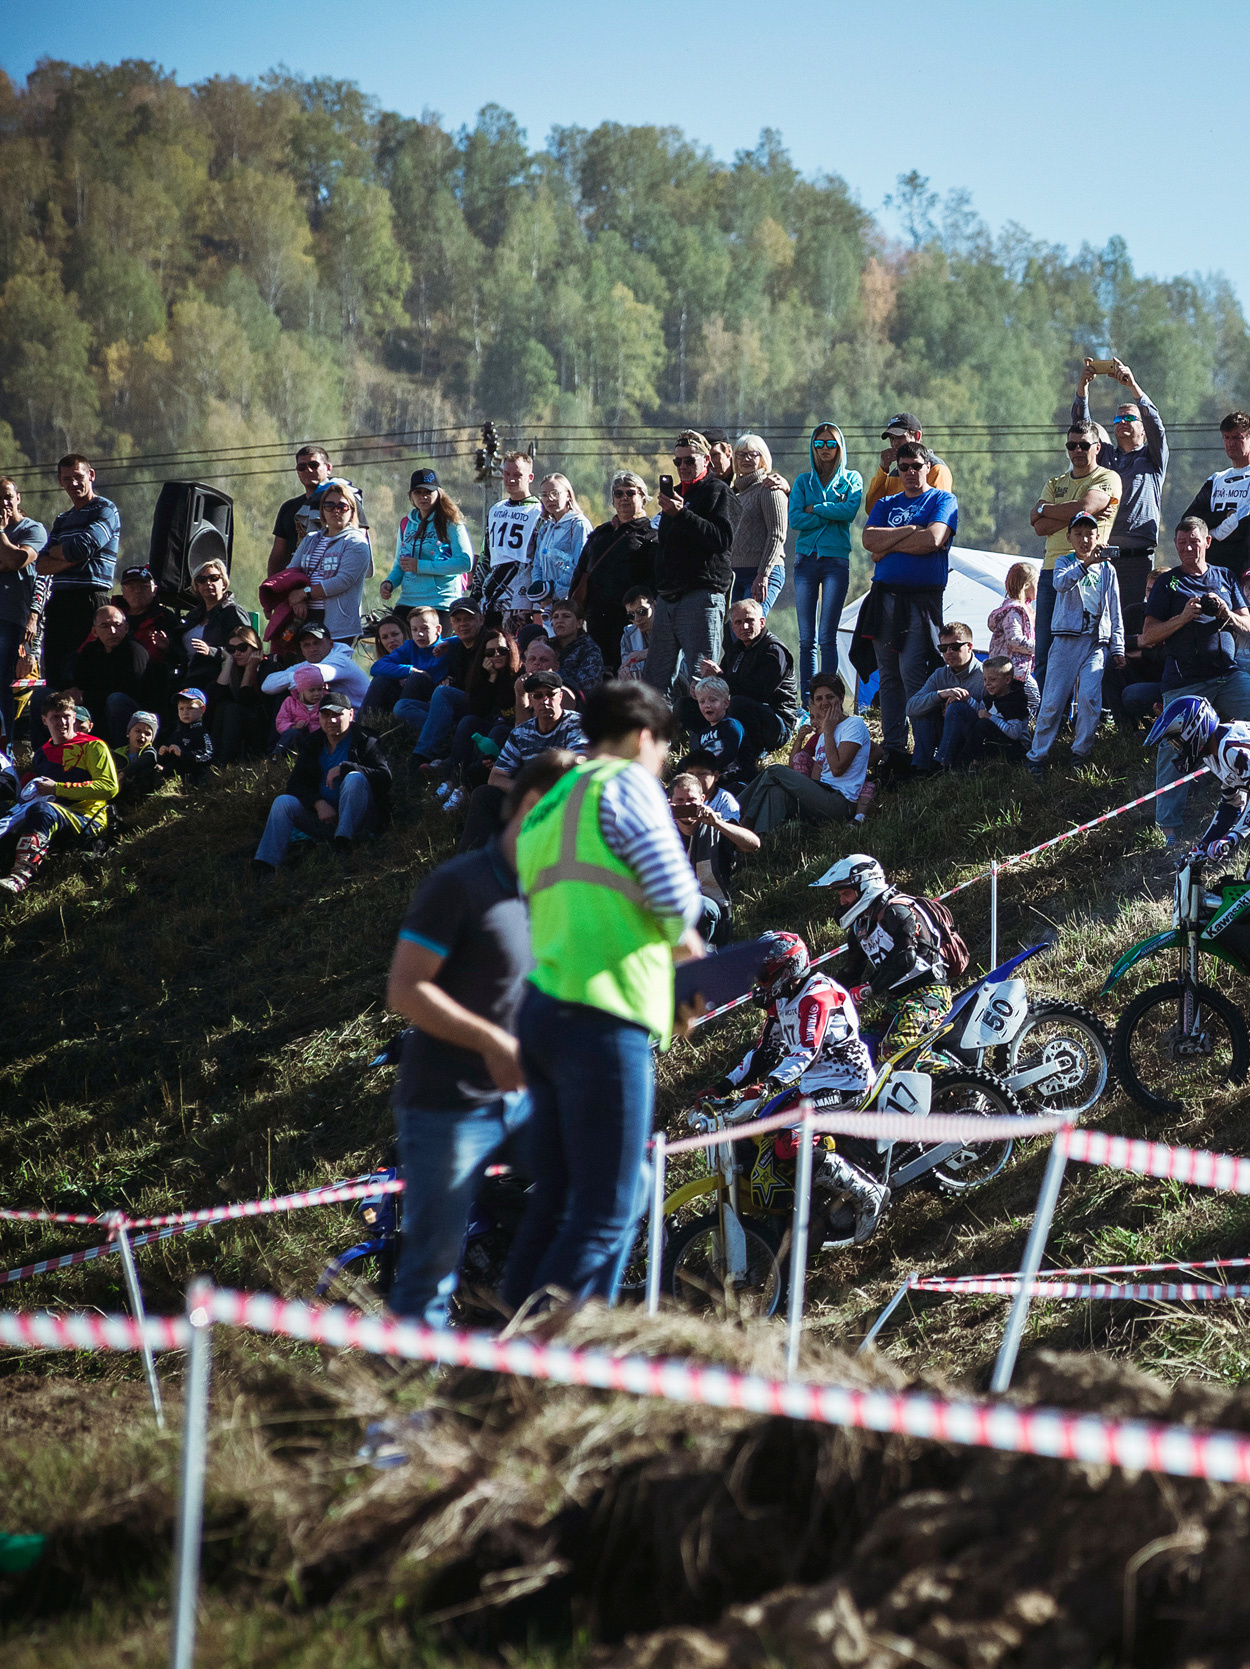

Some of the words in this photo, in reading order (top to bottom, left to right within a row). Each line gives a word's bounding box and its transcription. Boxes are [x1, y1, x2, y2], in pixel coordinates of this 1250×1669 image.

[490, 521, 524, 549] 115
[981, 998, 1014, 1032] 50
[812, 1095, 840, 1108] AMAHA
